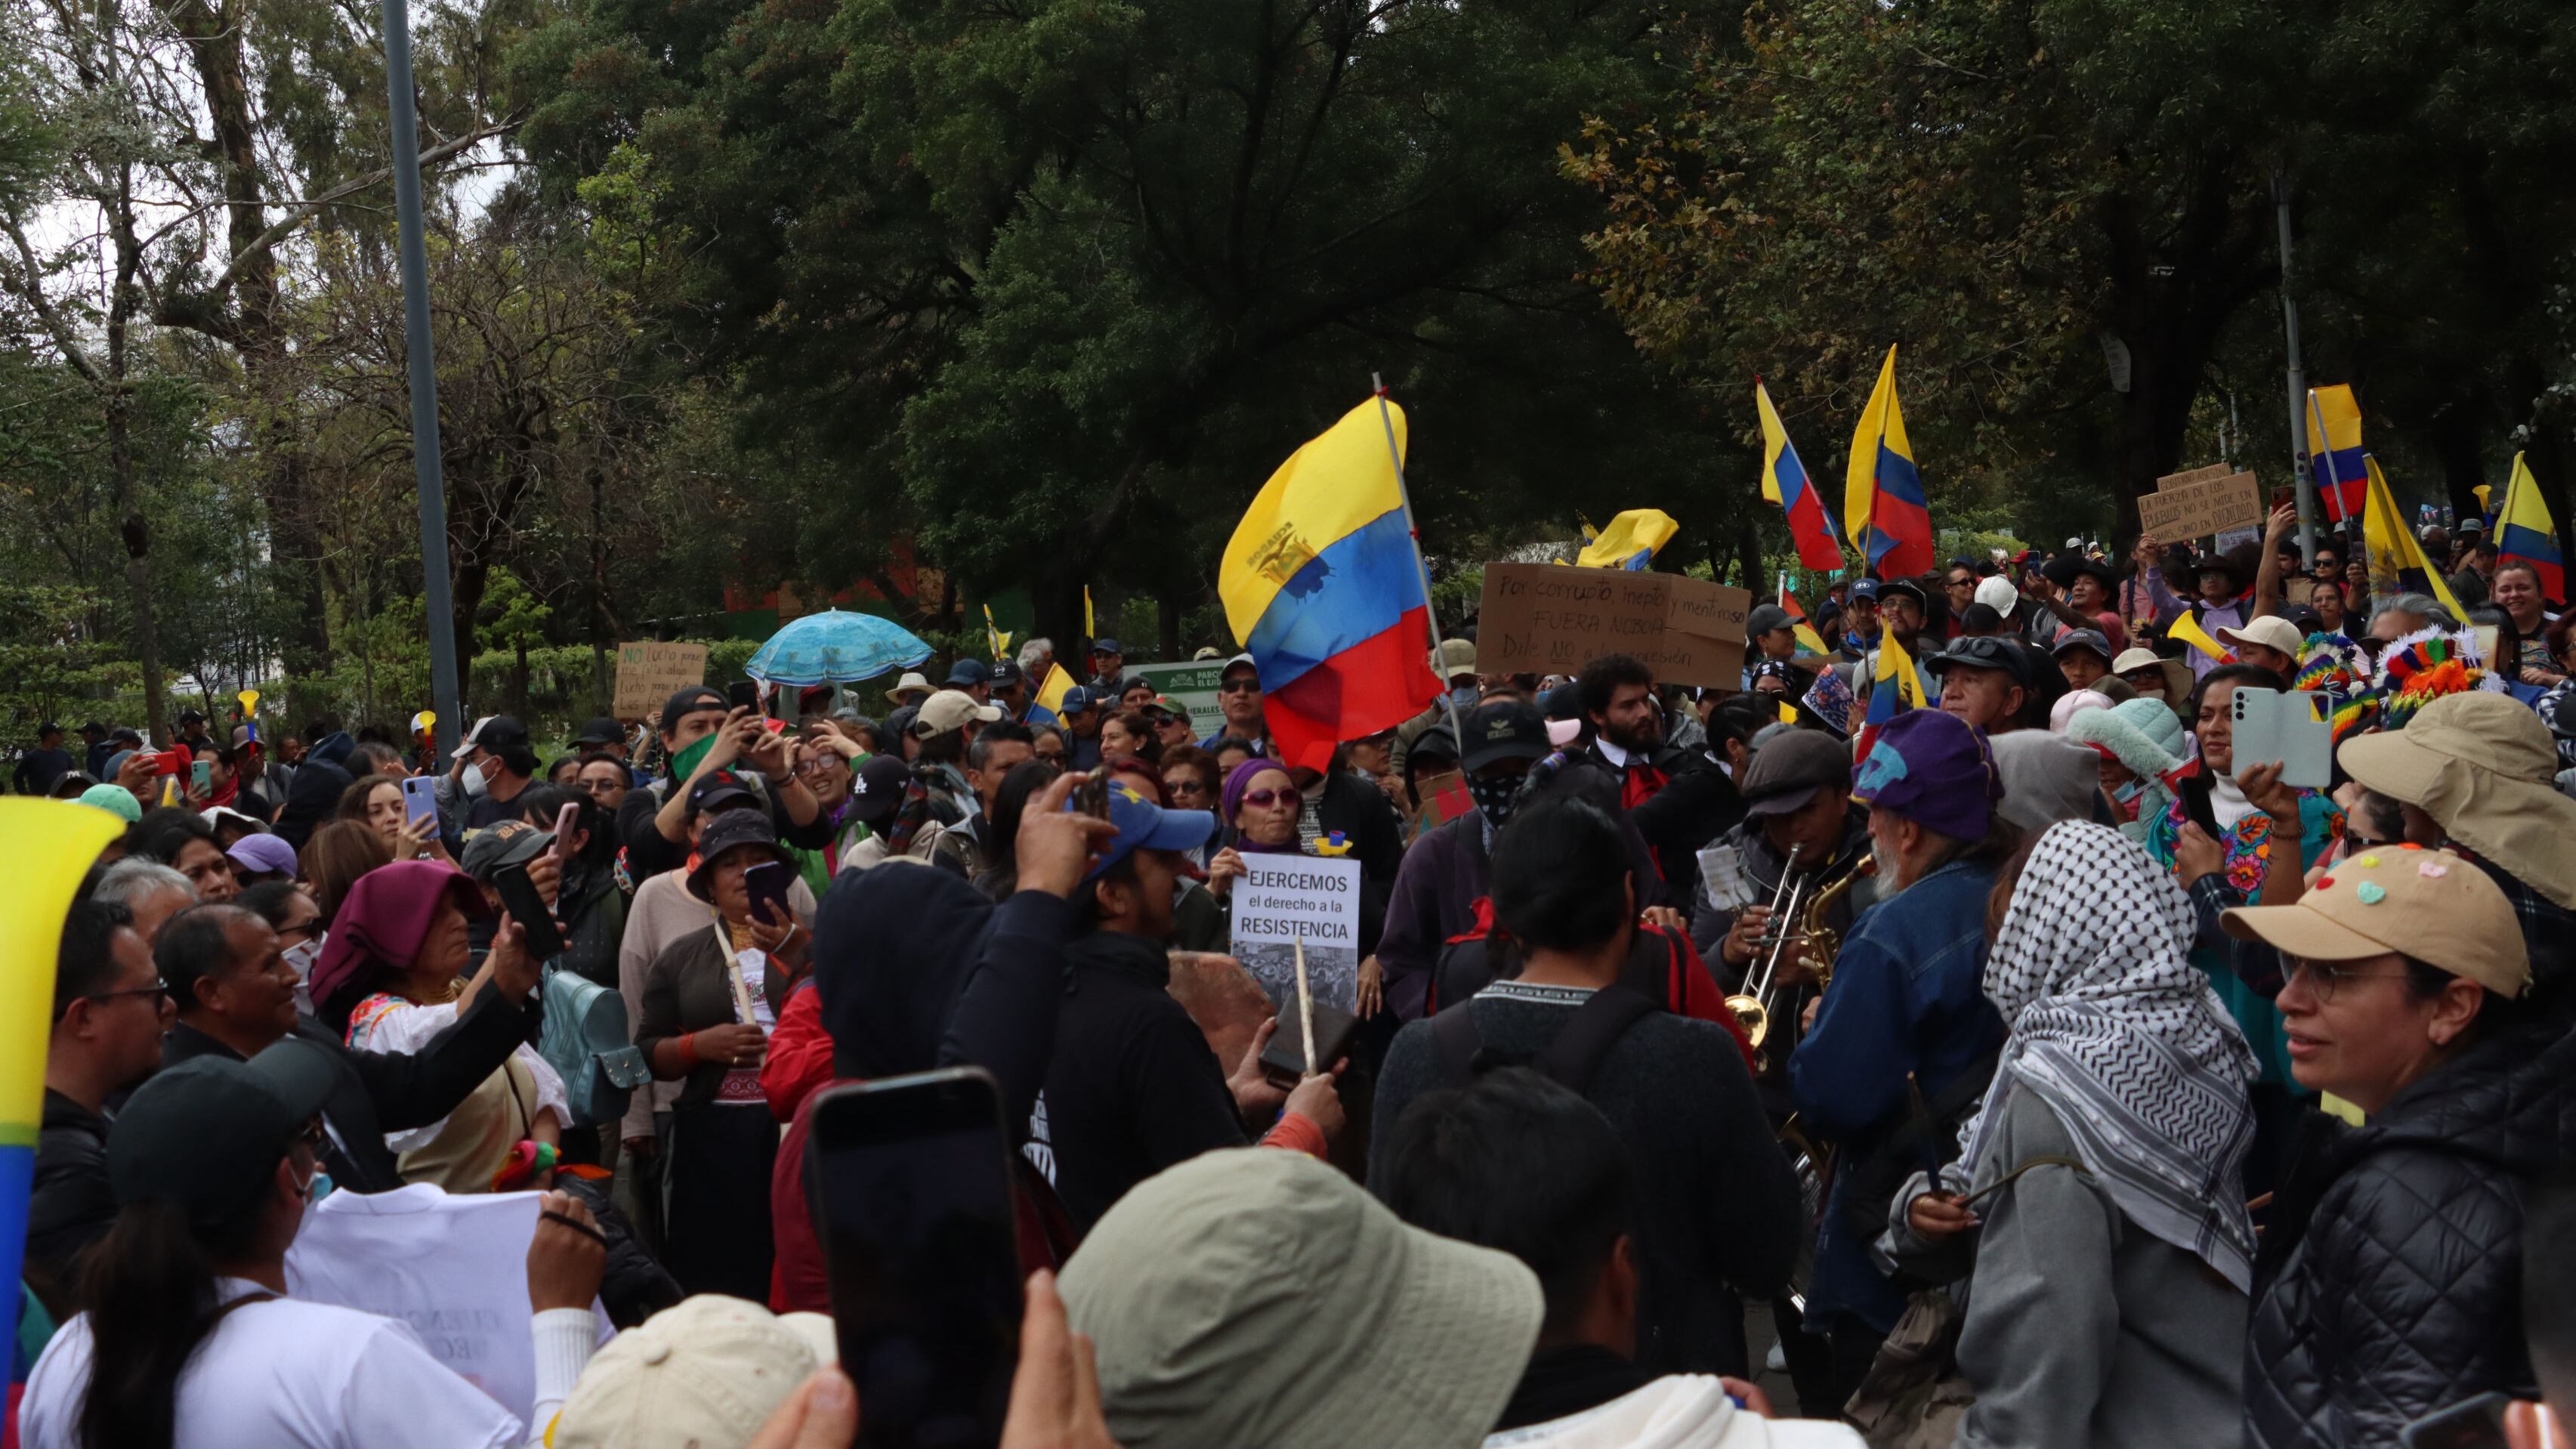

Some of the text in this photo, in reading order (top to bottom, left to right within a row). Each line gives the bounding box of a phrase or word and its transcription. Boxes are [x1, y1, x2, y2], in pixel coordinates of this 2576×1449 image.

[2140, 480, 2225, 513] LA FUERZA DE LOS
[2144, 489, 2252, 528] PUEBLOS NO SE MIDE EN
[2200, 518, 2210, 530] EN
[2212, 502, 2255, 527] DIGNIDAD
[1500, 576, 1745, 623] Por corrupto, inepto y mentiroso
[1534, 610, 1663, 635] FUERA NOBOA
[623, 647, 643, 664] NO
[681, 652, 702, 666] porque
[1502, 632, 1540, 658] Dile
[1550, 641, 1575, 659] NO
[622, 663, 687, 680] me falta algo
[1197, 671, 1221, 679] PARQ
[1198, 678, 1222, 687] EL EJID
[620, 678, 646, 694] Lucho
[620, 697, 639, 710] Les
[1249, 870, 1347, 892] EJERCEMOS
[1249, 894, 1342, 913] el derecho a la
[1241, 917, 1348, 939] RESISTENCIA
